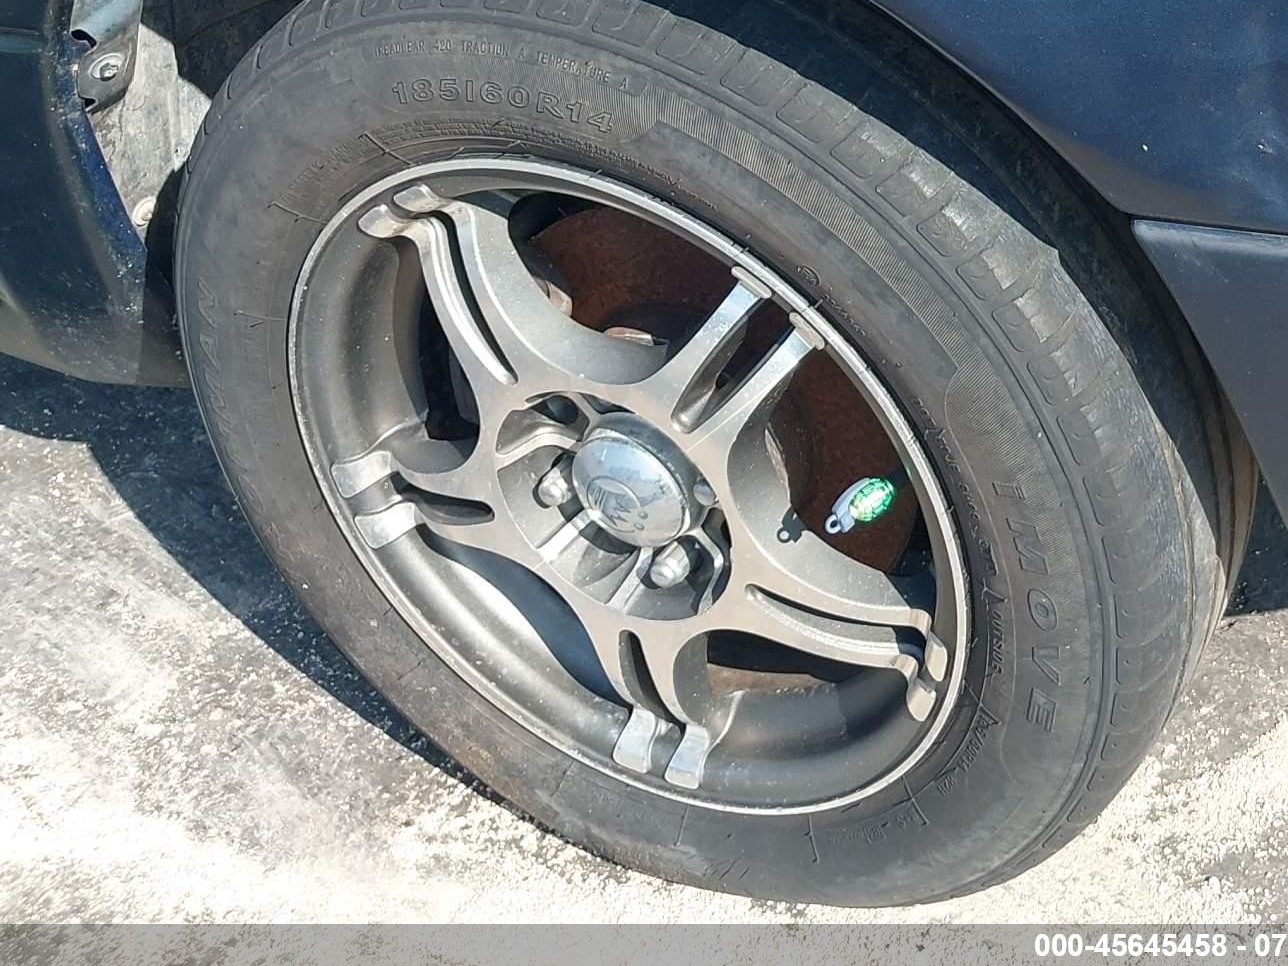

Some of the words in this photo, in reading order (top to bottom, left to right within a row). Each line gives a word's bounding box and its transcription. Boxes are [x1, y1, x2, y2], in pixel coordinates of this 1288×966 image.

[432, 38, 452, 52] 420
[462, 40, 509, 59] TRACTION
[519, 45, 527, 60] A
[536, 50, 612, 84] TEMPERATURE
[618, 75, 630, 91] A
